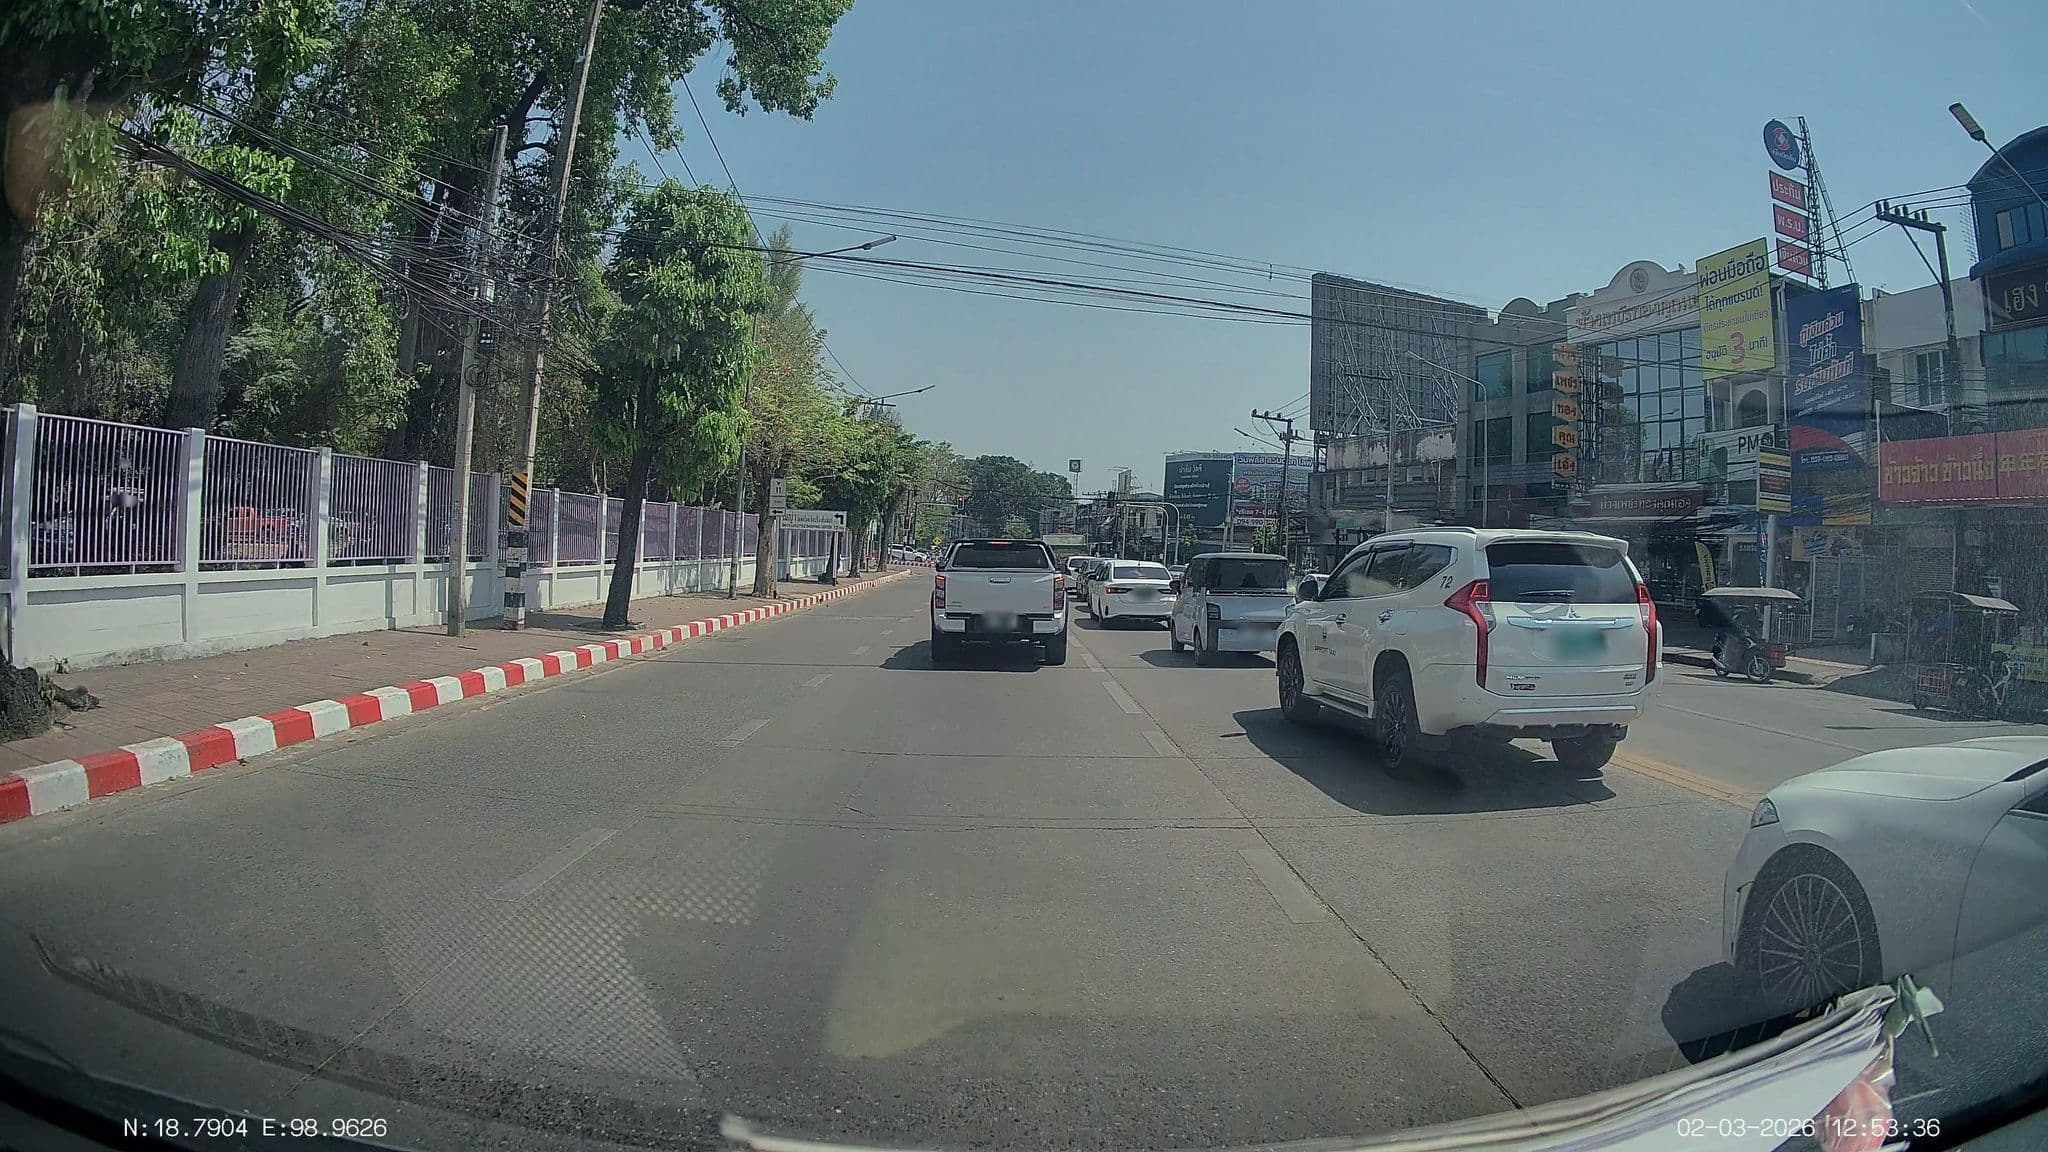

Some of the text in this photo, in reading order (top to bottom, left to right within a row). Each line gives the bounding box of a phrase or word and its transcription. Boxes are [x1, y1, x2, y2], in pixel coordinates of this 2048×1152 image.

[1772, 178, 1802, 201] ประกัน
[1777, 213, 1804, 233] พ.ร.บ.
[1700, 251, 1766, 288] ผ่อนมือถือ
[1730, 331, 1746, 364] 3
[1440, 575, 1453, 588] 72
